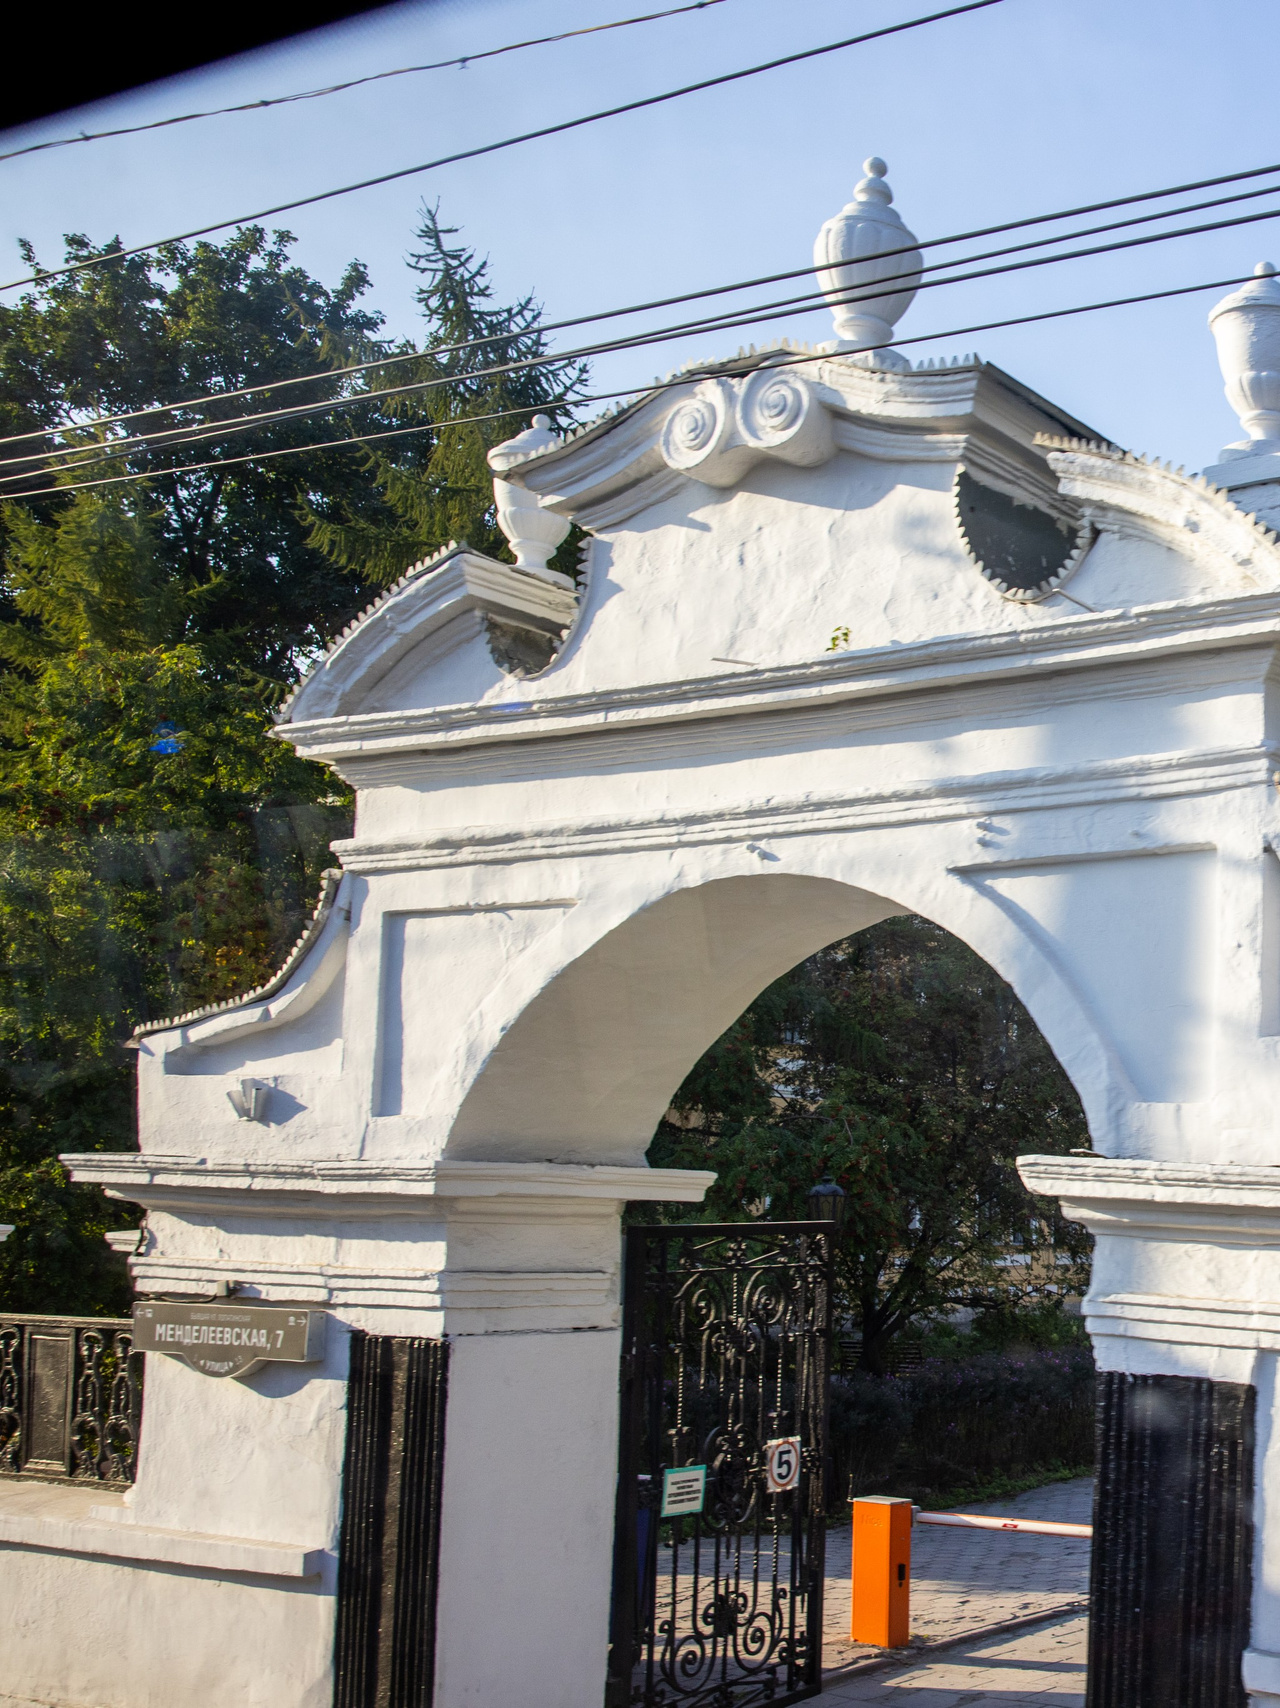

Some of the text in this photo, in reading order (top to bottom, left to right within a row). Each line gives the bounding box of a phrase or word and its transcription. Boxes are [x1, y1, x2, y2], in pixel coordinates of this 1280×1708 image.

[155, 1323, 285, 1351] МЕНДЕЛЕЕВСКАЯ, 7
[204, 1360, 230, 1374] УЛИЦА
[777, 1449, 792, 1480] 5
